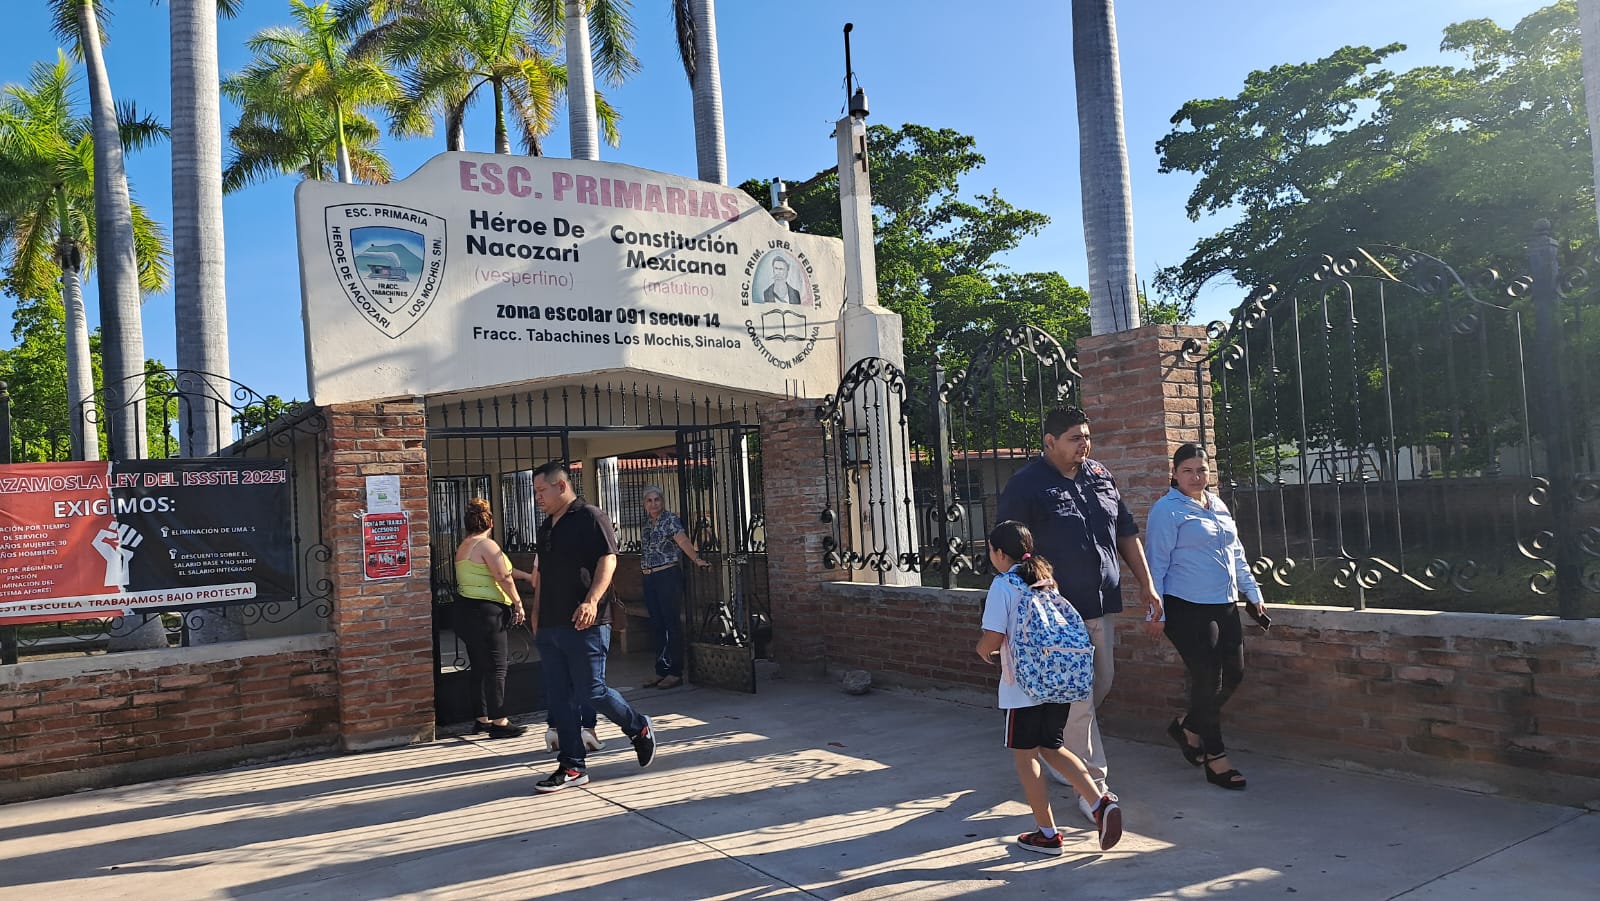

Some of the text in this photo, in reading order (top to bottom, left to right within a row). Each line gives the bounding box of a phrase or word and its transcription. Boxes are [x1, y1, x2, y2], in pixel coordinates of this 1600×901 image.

[459, 160, 740, 222] ESC. PRIMARIAS
[345, 208, 428, 226] ESC. PRIMARIA
[469, 209, 585, 239] Héroe De
[466, 234, 579, 262] Nacozari
[610, 224, 738, 255] Constitución
[626, 249, 726, 276] Mexicana
[331, 226, 391, 329] HEROE DE NACOZARI
[475, 265, 574, 291] (vespertino)
[745, 248, 765, 276] PRIM.
[768, 240, 793, 252] URB.
[796, 252, 814, 278] FED.
[812, 284, 822, 310] MAT.
[371, 289, 409, 297] TABACHINES
[643, 278, 714, 300] (matutino)
[408, 298, 426, 318] LOS
[496, 304, 720, 328] zona escolar 091 sector 14
[473, 326, 522, 341] Fracc.
[526, 328, 610, 345] Tabachines
[615, 331, 640, 345] Los
[745, 319, 820, 369] CONSTITUCION MEXICANA
[106, 472, 140, 489] LEY
[143, 472, 179, 487] DEL
[182, 470, 238, 486] ISSSTE
[241, 469, 286, 484] 2025!
[54, 496, 176, 518] EXIGIMOS:
[15, 533, 48, 541] SERVICIO
[18, 549, 58, 557] HOMBRES)
[7, 573, 38, 581] PENSIÓN
[187, 568, 215, 576] SALARIO
[30, 601, 82, 611] ESCUELA
[88, 594, 163, 607] TRABAJAMOS
[166, 592, 194, 602] BAJO
[196, 587, 252, 599] PROTESTA!
